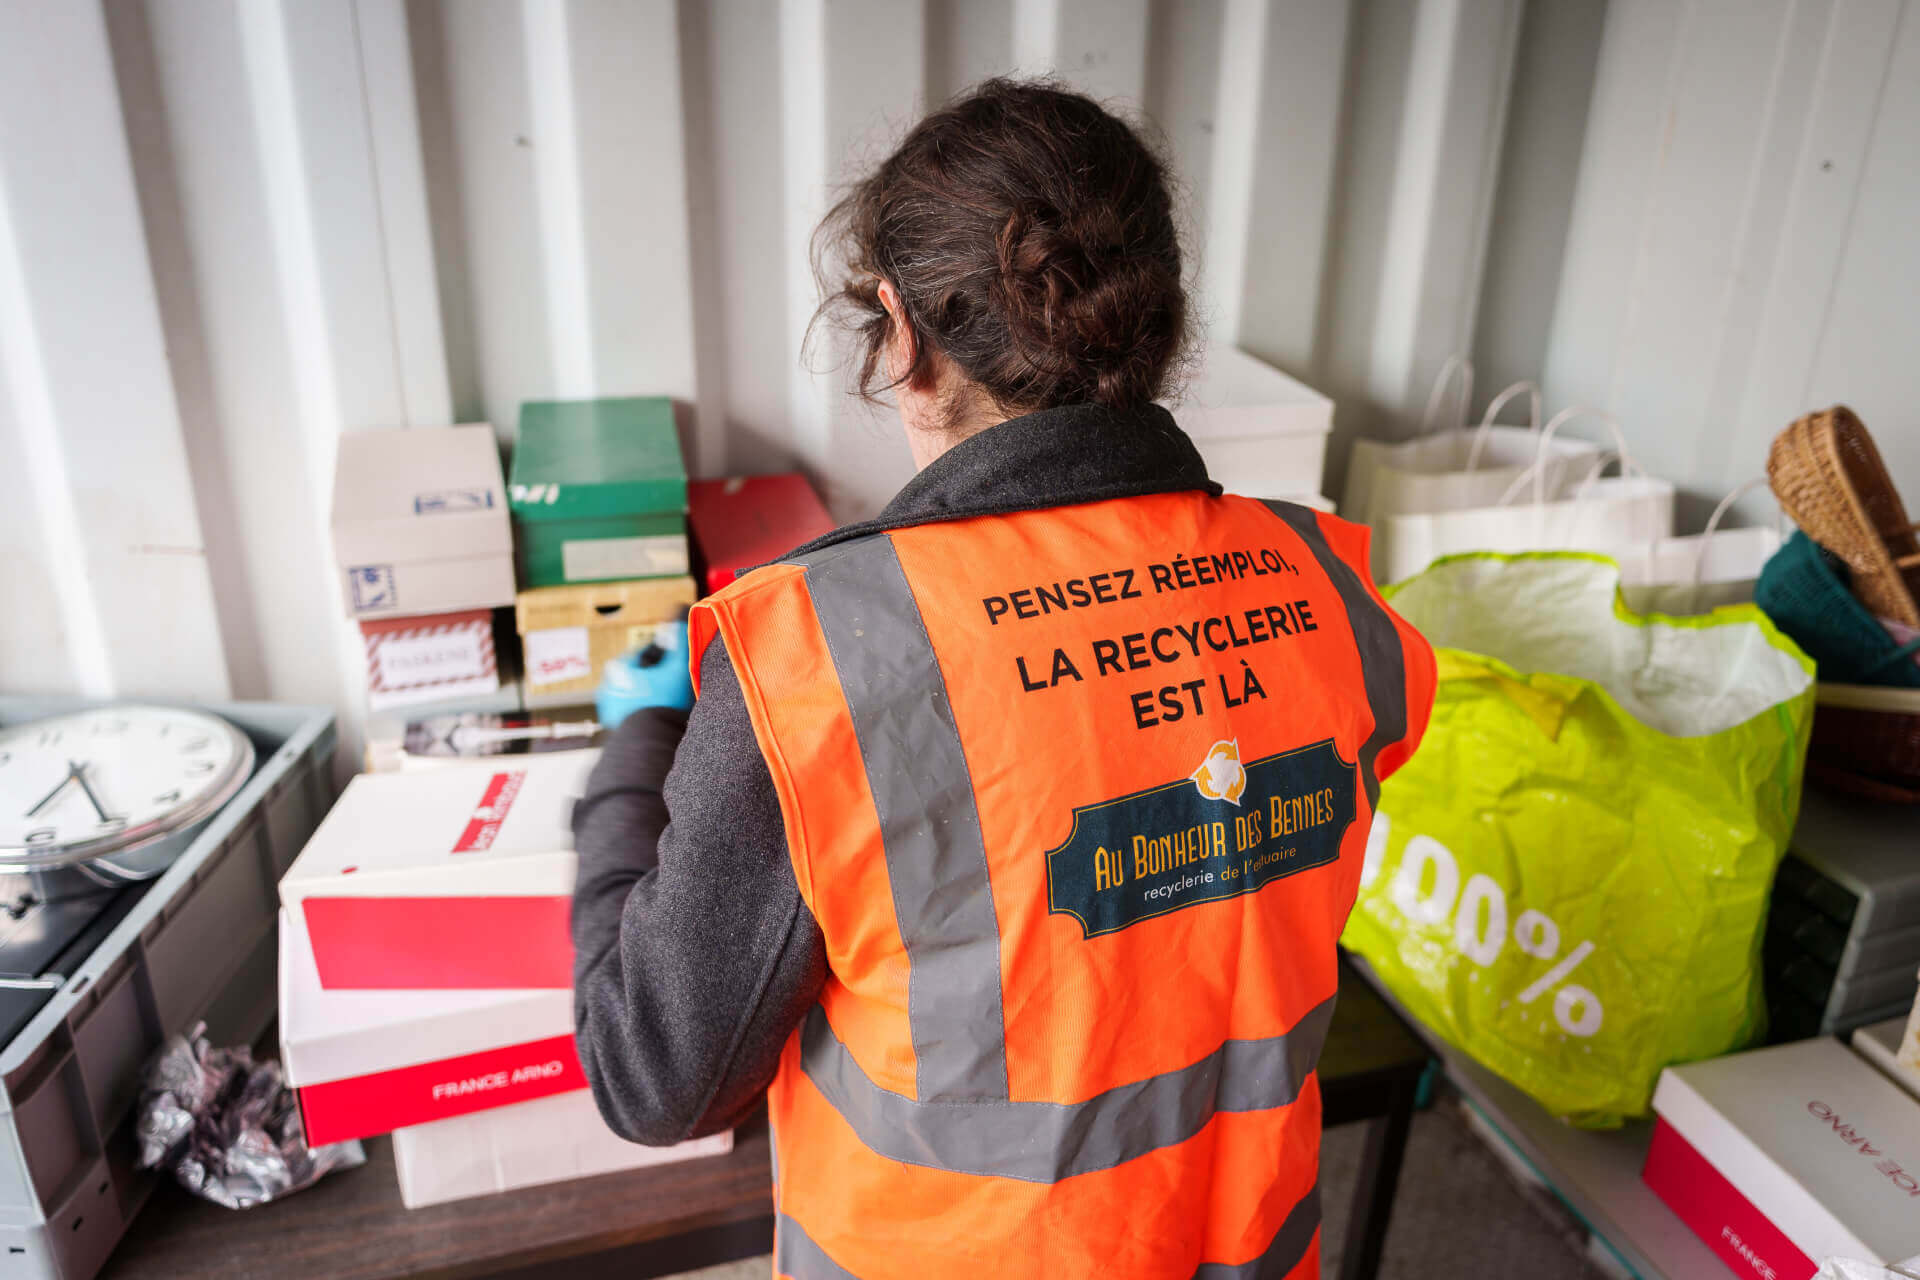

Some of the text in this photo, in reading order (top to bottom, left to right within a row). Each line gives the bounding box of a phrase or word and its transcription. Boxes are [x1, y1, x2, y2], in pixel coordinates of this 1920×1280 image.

[982, 549, 1299, 626] PENSEZ RÉEMPLOI,
[1016, 600, 1318, 692] LA RECYCLERIE
[1131, 659, 1267, 729] EST LÀ
[1094, 788, 1334, 891] AU BONHEUR DES BENNES
[1144, 870, 1214, 901] recyclerie
[1221, 865, 1239, 881] de
[432, 1060, 563, 1100] FRANCE ARNO
[1807, 1101, 1882, 1156] ARNO
